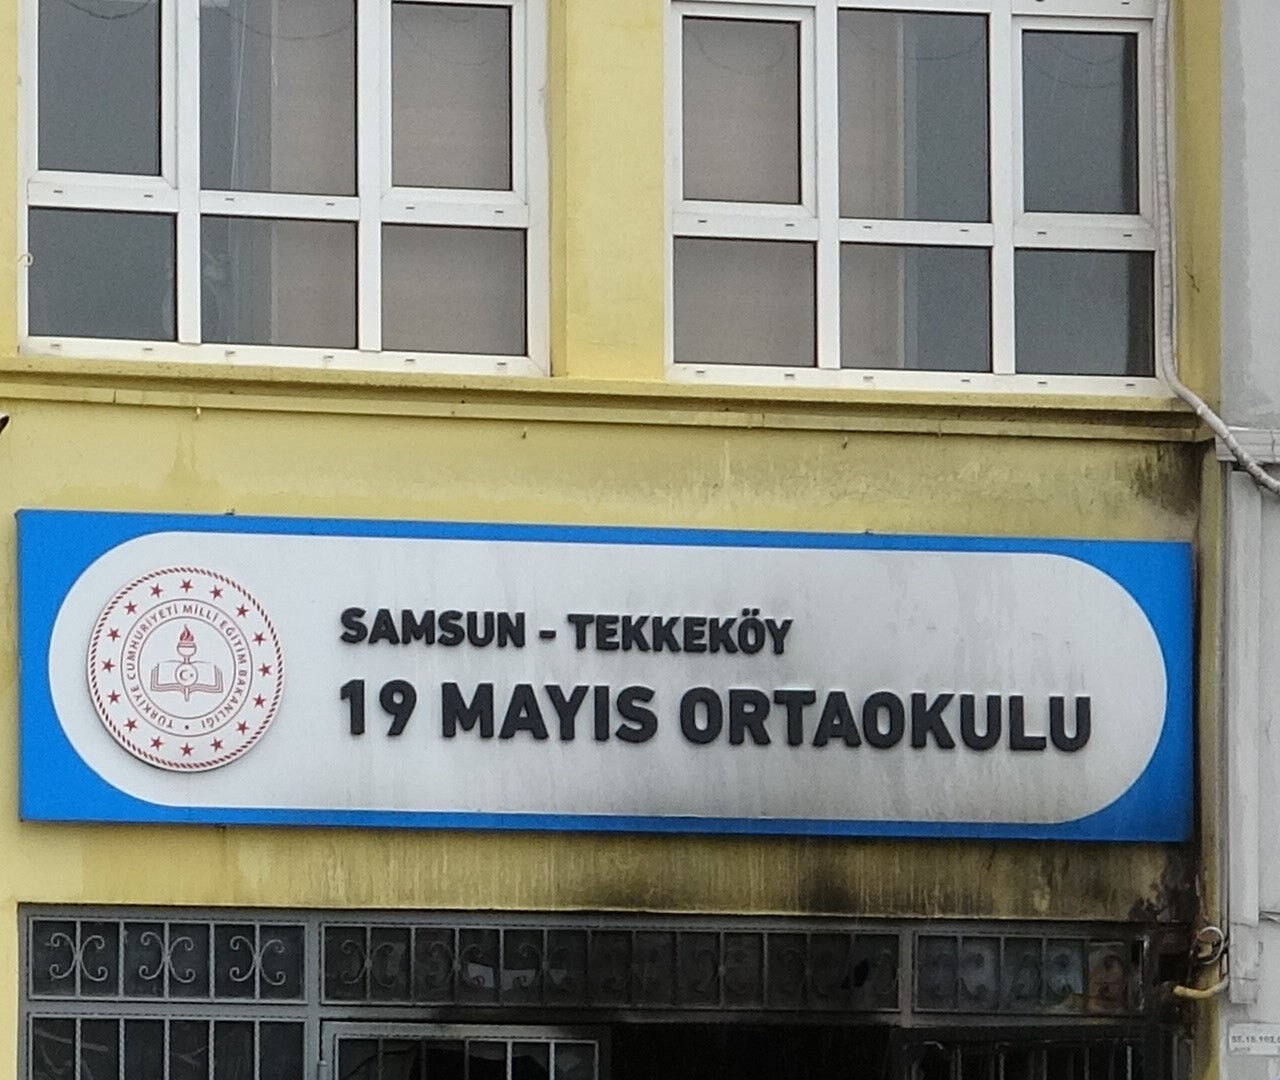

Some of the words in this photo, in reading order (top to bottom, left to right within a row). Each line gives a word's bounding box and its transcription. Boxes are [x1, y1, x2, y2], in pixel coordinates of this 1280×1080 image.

[183, 604, 219, 622] MİLLİ
[339, 606, 526, 648] SAMSUN
[567, 608, 794, 656] TEKKEKÖY
[126, 603, 178, 680] CUMHURİYETİ
[220, 620, 247, 664] EĞİTİM
[130, 684, 174, 729] TÜRKİYE
[201, 669, 248, 729] BAKANLIĞI
[339, 679, 418, 737] 19
[441, 681, 660, 744] MAYIS
[679, 686, 1092, 753] ORTAOKULU
